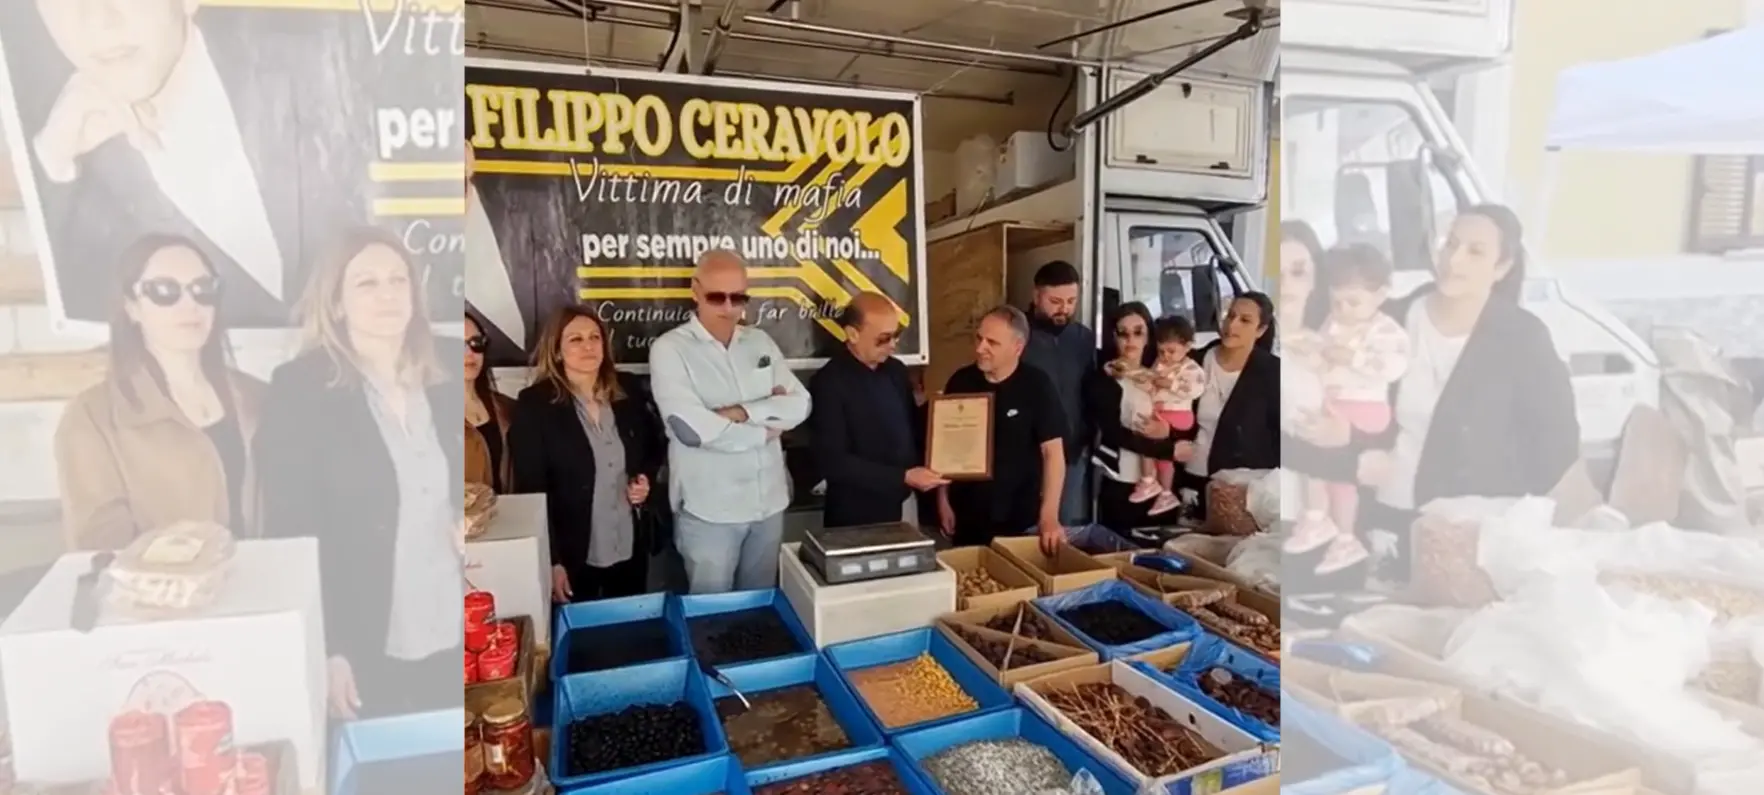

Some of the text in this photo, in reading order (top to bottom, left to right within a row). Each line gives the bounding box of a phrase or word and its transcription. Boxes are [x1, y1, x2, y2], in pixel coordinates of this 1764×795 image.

[377, 107, 455, 159] per
[466, 84, 911, 168] FILIPPO CERAVOLO
[569, 156, 861, 223] Vittima di mafia
[582, 233, 629, 265] per
[742, 235, 788, 260] uno
[796, 230, 818, 260] di
[826, 231, 880, 260] noi...
[756, 300, 788, 326] far
